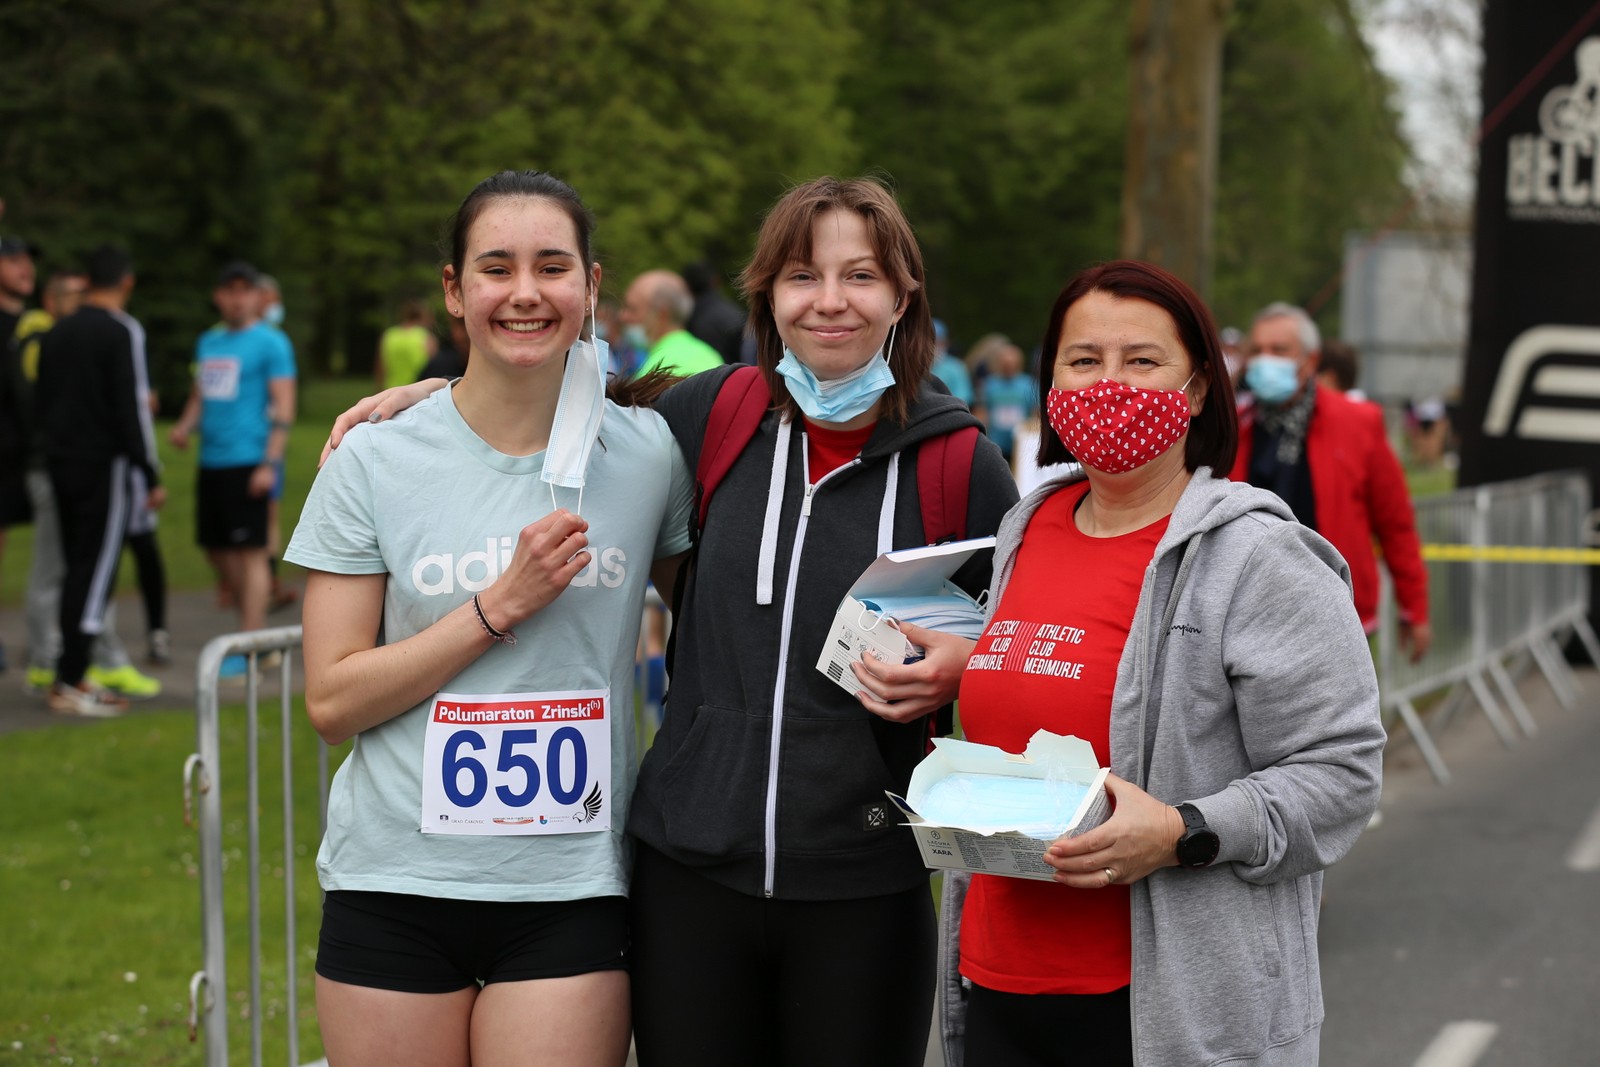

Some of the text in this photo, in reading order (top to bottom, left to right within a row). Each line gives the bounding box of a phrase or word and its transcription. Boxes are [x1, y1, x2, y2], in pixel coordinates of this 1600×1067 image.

[1508, 133, 1600, 206] BEC
[412, 536, 626, 596] adias
[986, 620, 1020, 636] ATLETSKI
[1036, 623, 1085, 644] ATHLETIC
[1167, 623, 1202, 637] mpion
[989, 637, 1012, 653] KLUB
[1028, 640, 1056, 657] CLUB
[1022, 657, 1084, 680] MEĐIMURJE
[438, 706, 535, 722] Polumaraton
[442, 726, 588, 808] 650
[932, 848, 953, 856] XARA
